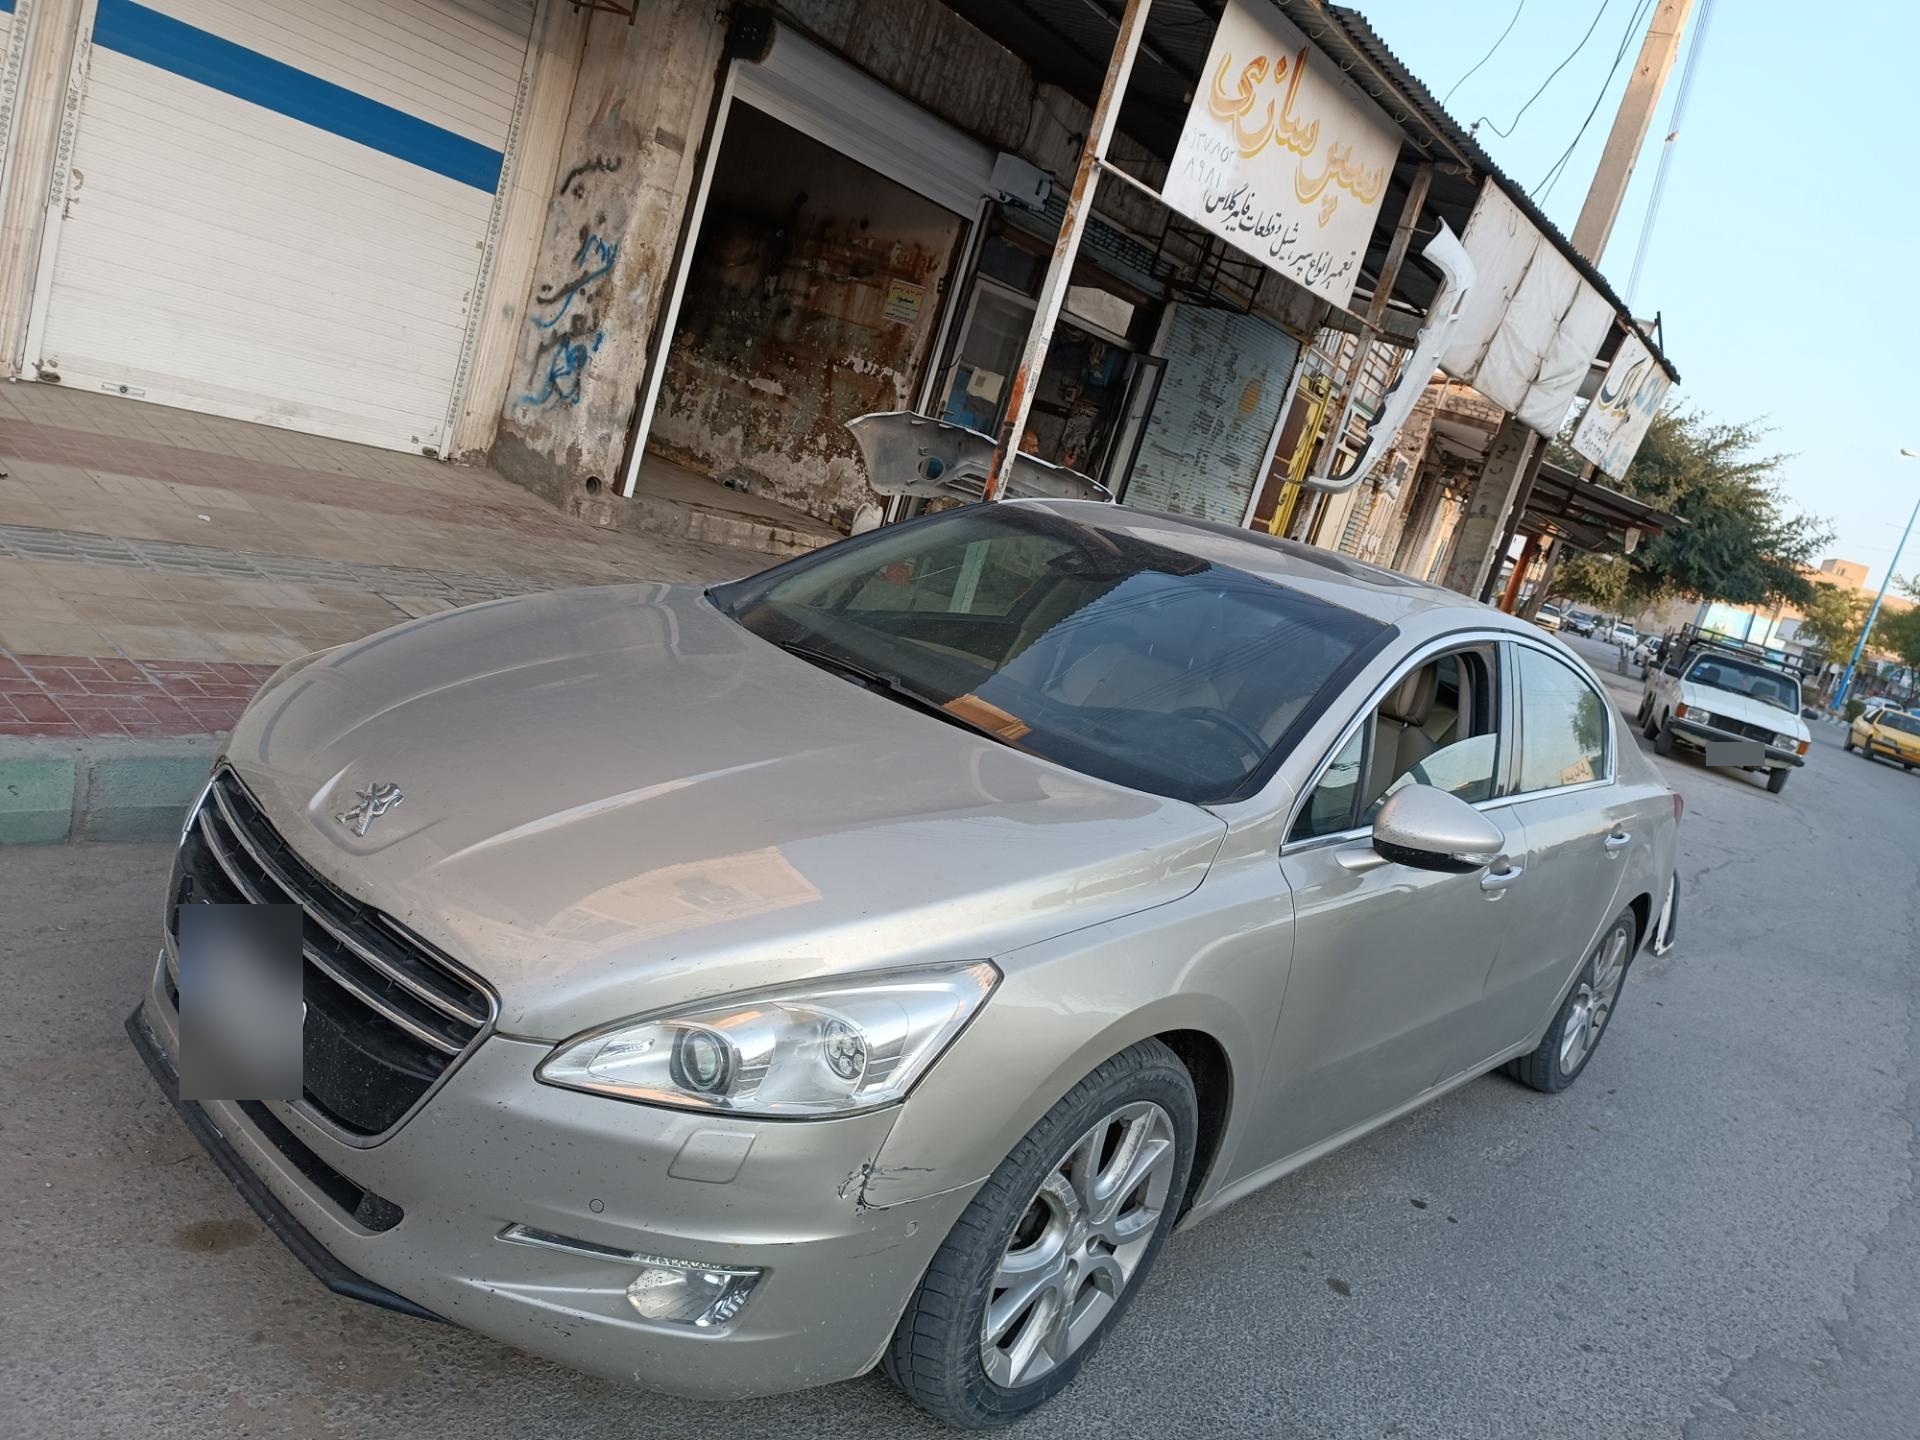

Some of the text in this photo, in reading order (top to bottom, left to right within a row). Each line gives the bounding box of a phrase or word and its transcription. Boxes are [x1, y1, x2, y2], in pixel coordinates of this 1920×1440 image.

[1208, 46, 1384, 228] سپر سازی
[1305, 251, 1333, 286] انواع
